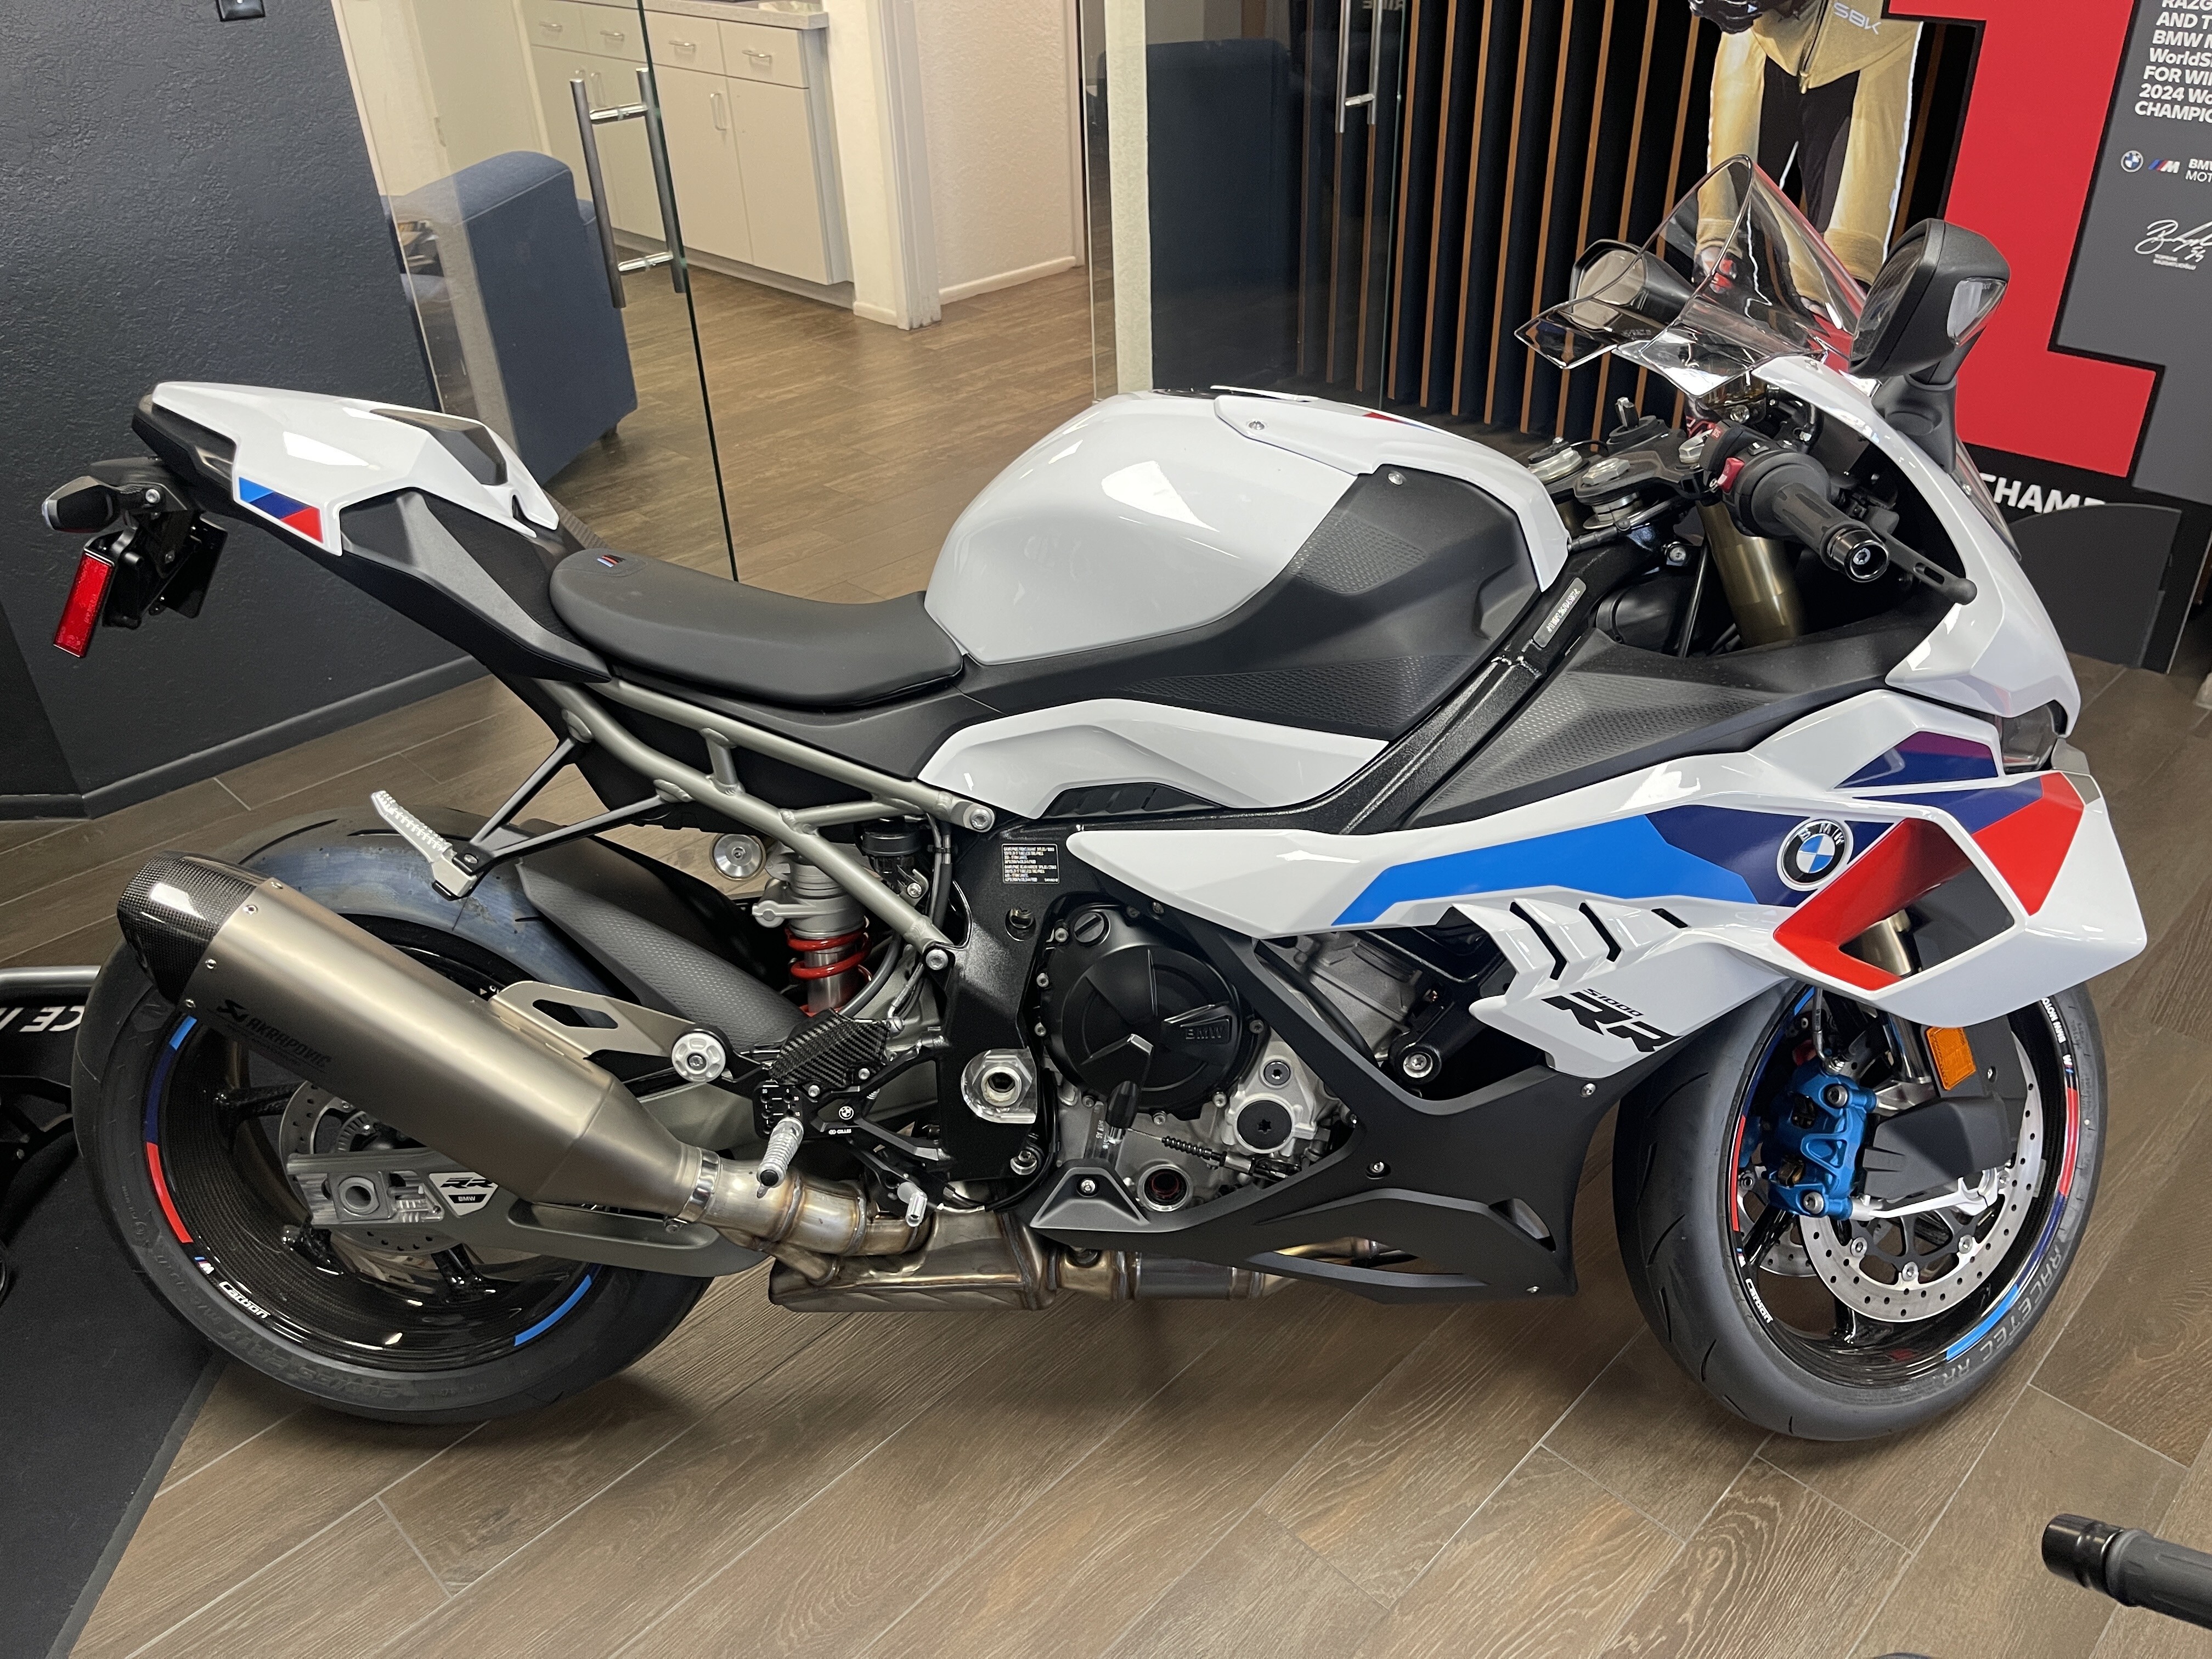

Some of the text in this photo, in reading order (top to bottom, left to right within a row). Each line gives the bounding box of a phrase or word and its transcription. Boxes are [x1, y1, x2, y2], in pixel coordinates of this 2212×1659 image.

[1833, 2, 1882, 35] SBK
[2155, 12, 2198, 28] AND
[2152, 30, 2204, 47] BMW
[2149, 47, 2212, 67] WorldS
[2143, 65, 2182, 83] FOR
[2139, 83, 2185, 101] 2024
[1979, 472, 2105, 514] HAM
[1798, 823, 1844, 846] BMW
[1583, 988, 1644, 1017] S1000
[1185, 1026, 1223, 1040] BMW
[1541, 991, 1684, 1053] RR
[2052, 1021, 2066, 1043] BMW
[441, 1177, 494, 1189] RR
[219, 1281, 271, 1319] Carbon
[1979, 1245, 2062, 1362] RACETEC
